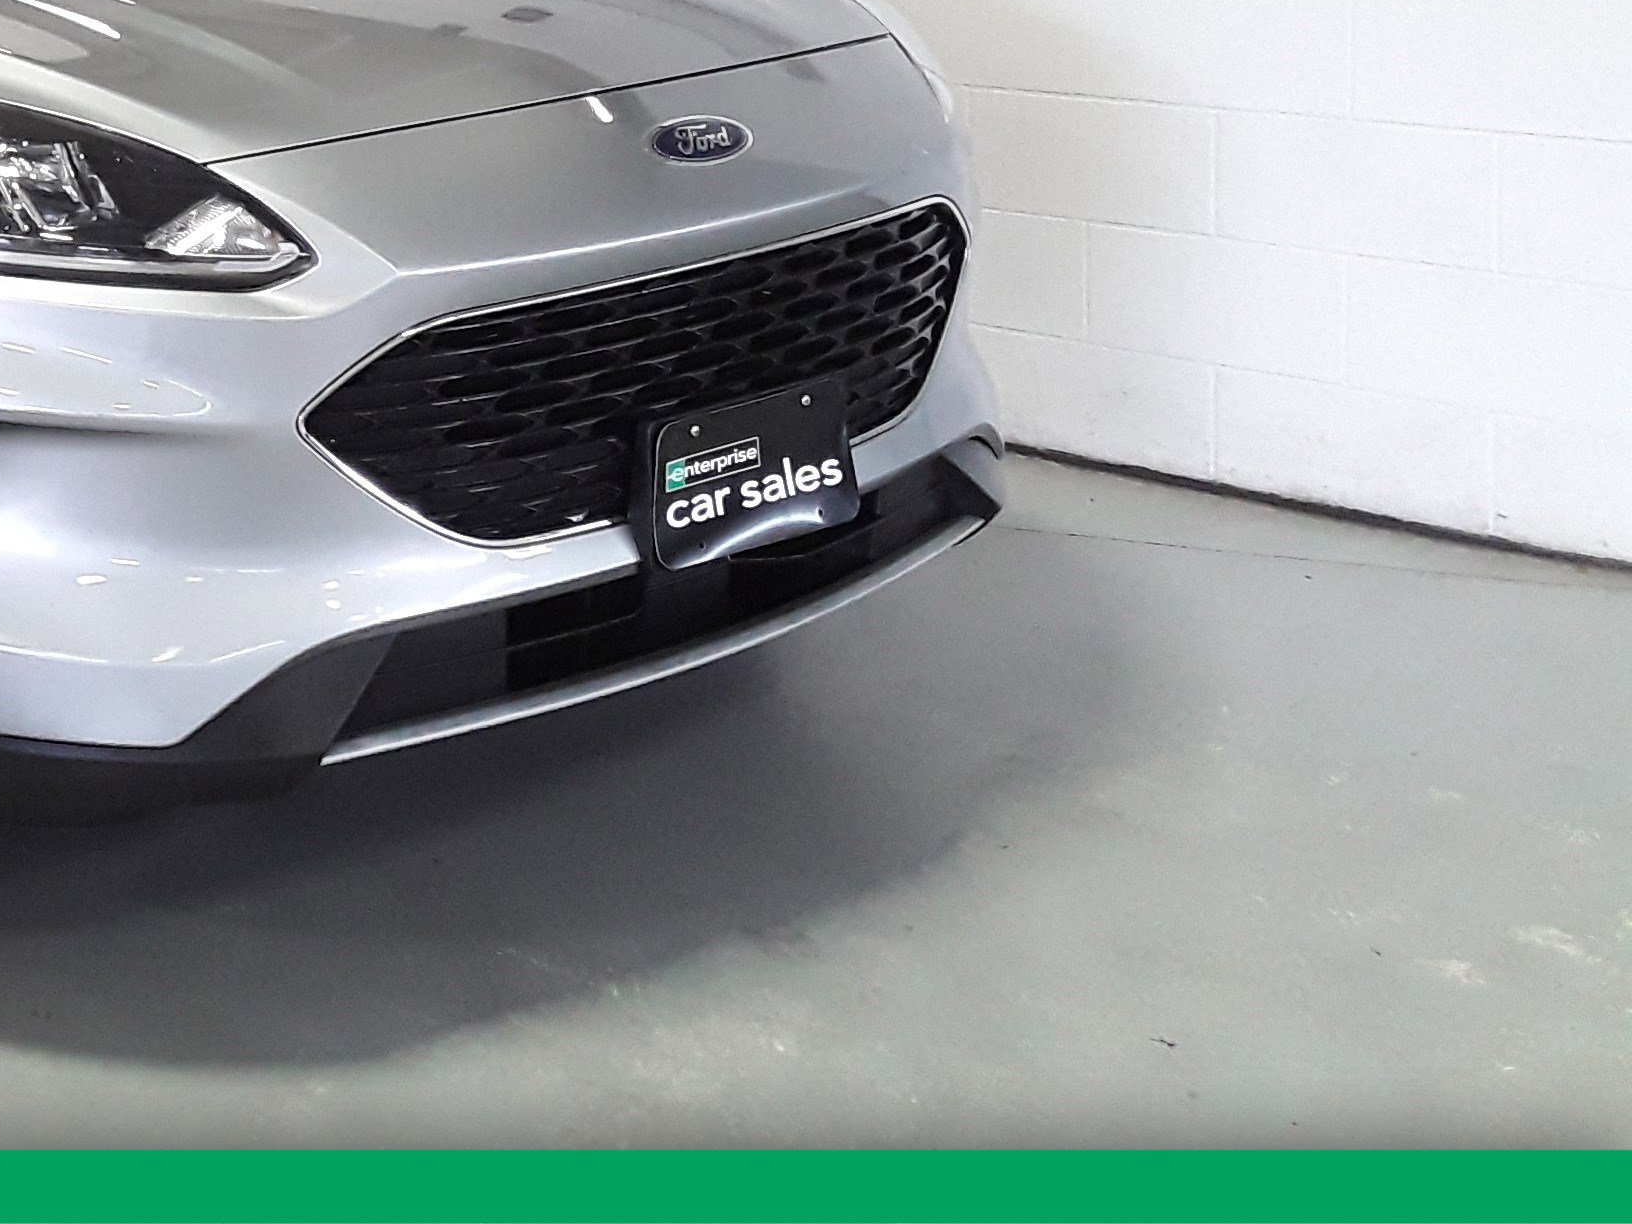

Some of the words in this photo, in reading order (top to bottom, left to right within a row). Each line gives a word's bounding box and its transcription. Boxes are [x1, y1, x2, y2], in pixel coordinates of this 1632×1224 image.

[675, 123, 731, 155] Ford
[668, 446, 758, 482] enterprise
[666, 485, 731, 529] car
[739, 456, 844, 509] sales
